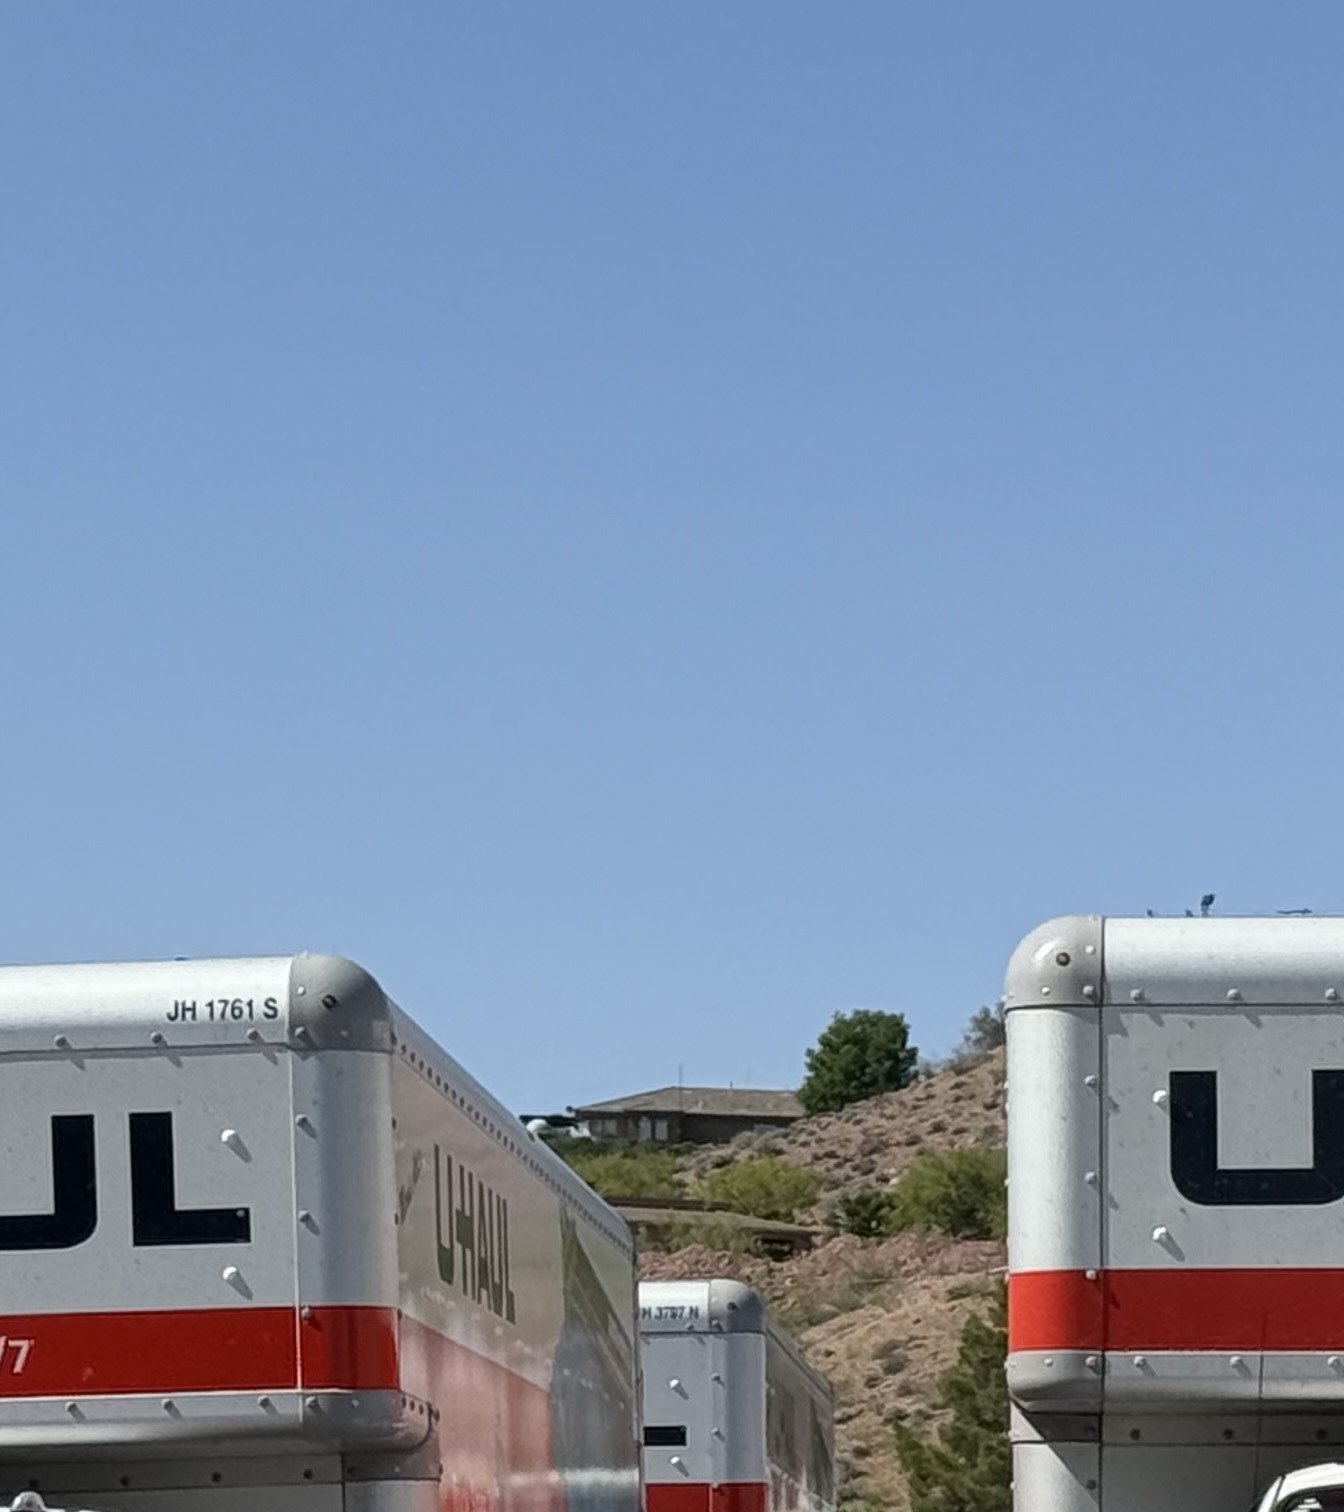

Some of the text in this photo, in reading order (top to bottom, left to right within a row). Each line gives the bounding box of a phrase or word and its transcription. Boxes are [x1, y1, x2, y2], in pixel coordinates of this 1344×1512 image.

[166, 997, 278, 1022] JH 1761 S
